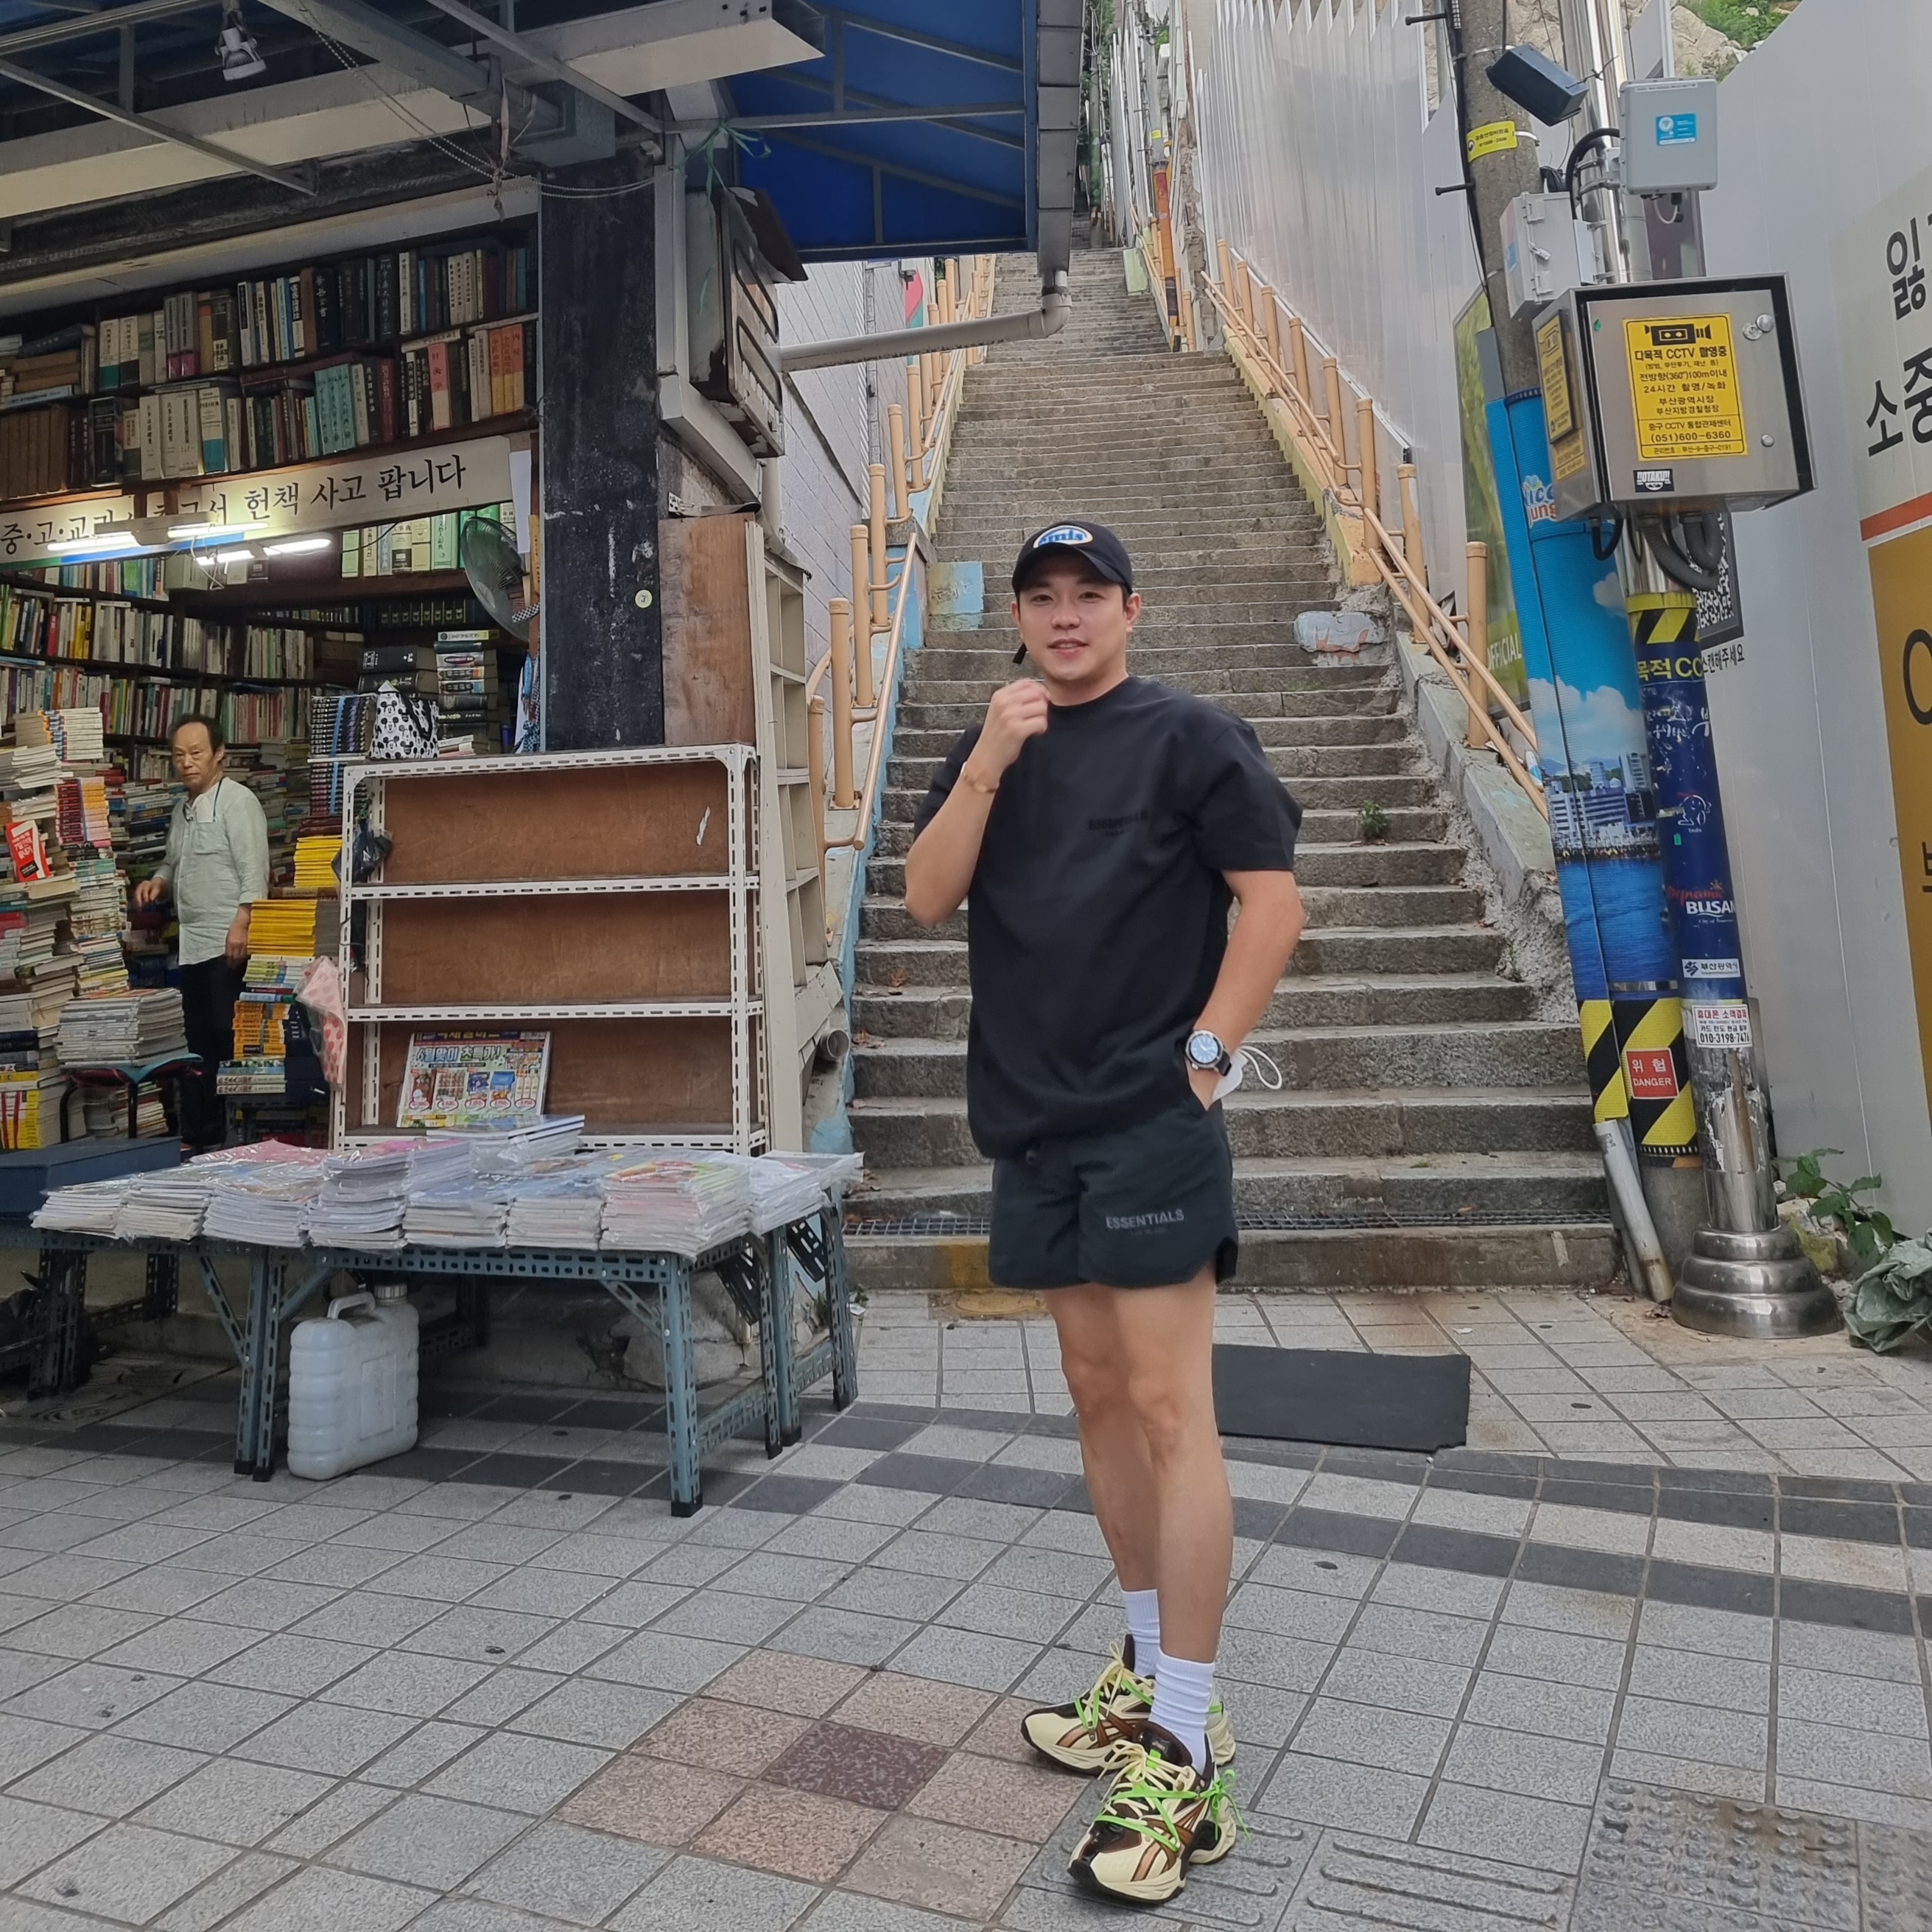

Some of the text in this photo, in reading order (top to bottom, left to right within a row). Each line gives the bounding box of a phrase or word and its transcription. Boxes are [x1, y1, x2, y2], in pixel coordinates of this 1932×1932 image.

[1886, 212, 1932, 320] 잃
[1634, 345, 1727, 361] 다목적 CCTV 촬영중
[1693, 359, 1706, 368] 재난
[1643, 381, 1726, 393] 24시간 촬영/녹화
[1659, 395, 1715, 406] 부산광역시장
[1657, 404, 1719, 415] 부산지방경찰청장
[1648, 419, 1732, 431] 중구 CCTV 통합관제센터
[1651, 430, 1731, 443] (051)600-6360
[1653, 446, 1676, 454] 관리번호
[244, 454, 467, 521] 헌책 사고 팝니다
[1702, 643, 1745, 674] 스캔해주세요
[1697, 1009, 1719, 1019] 휴대폰
[460, 1045, 502, 1061] 초특가!
[1631, 1058, 1666, 1072] 위 험
[1632, 1077, 1672, 1086] DANGER
[1106, 1209, 1184, 1229] ESSENTIALS
